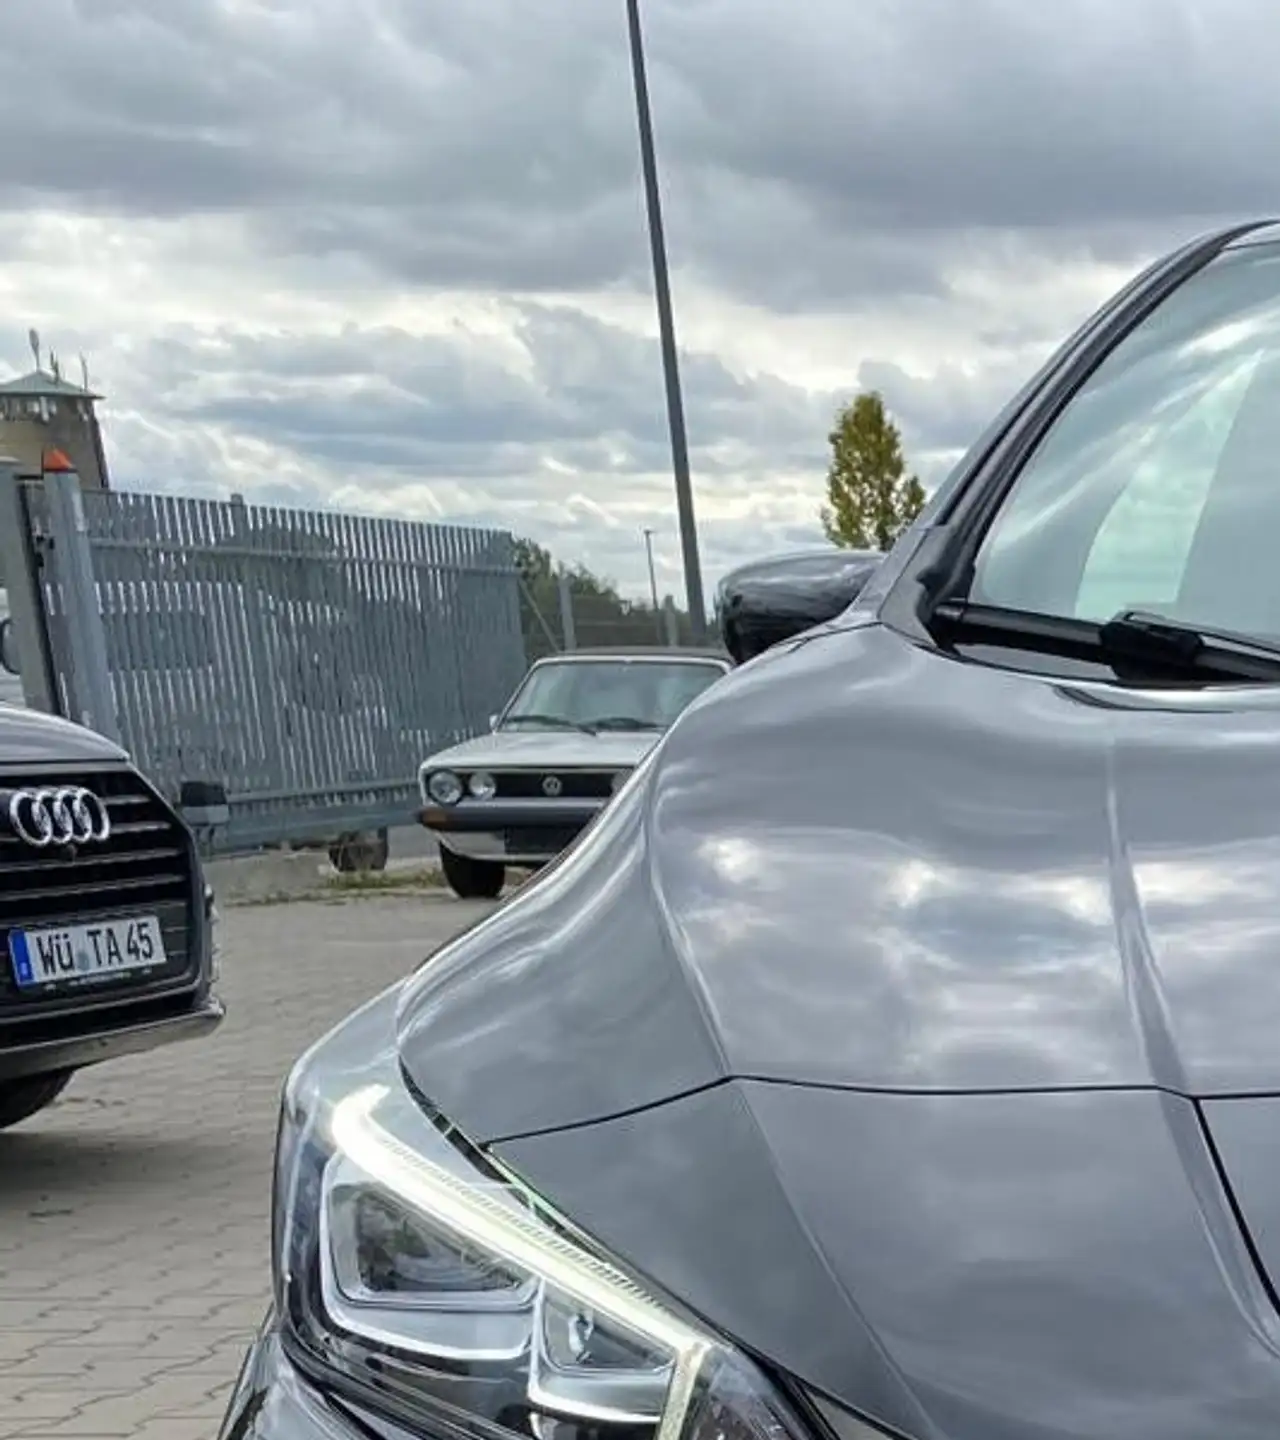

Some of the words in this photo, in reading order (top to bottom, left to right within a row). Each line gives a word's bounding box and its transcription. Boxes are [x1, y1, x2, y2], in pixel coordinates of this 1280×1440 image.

[36, 933, 75, 976] WÜ
[87, 928, 123, 967] TA
[127, 922, 153, 961] 45
